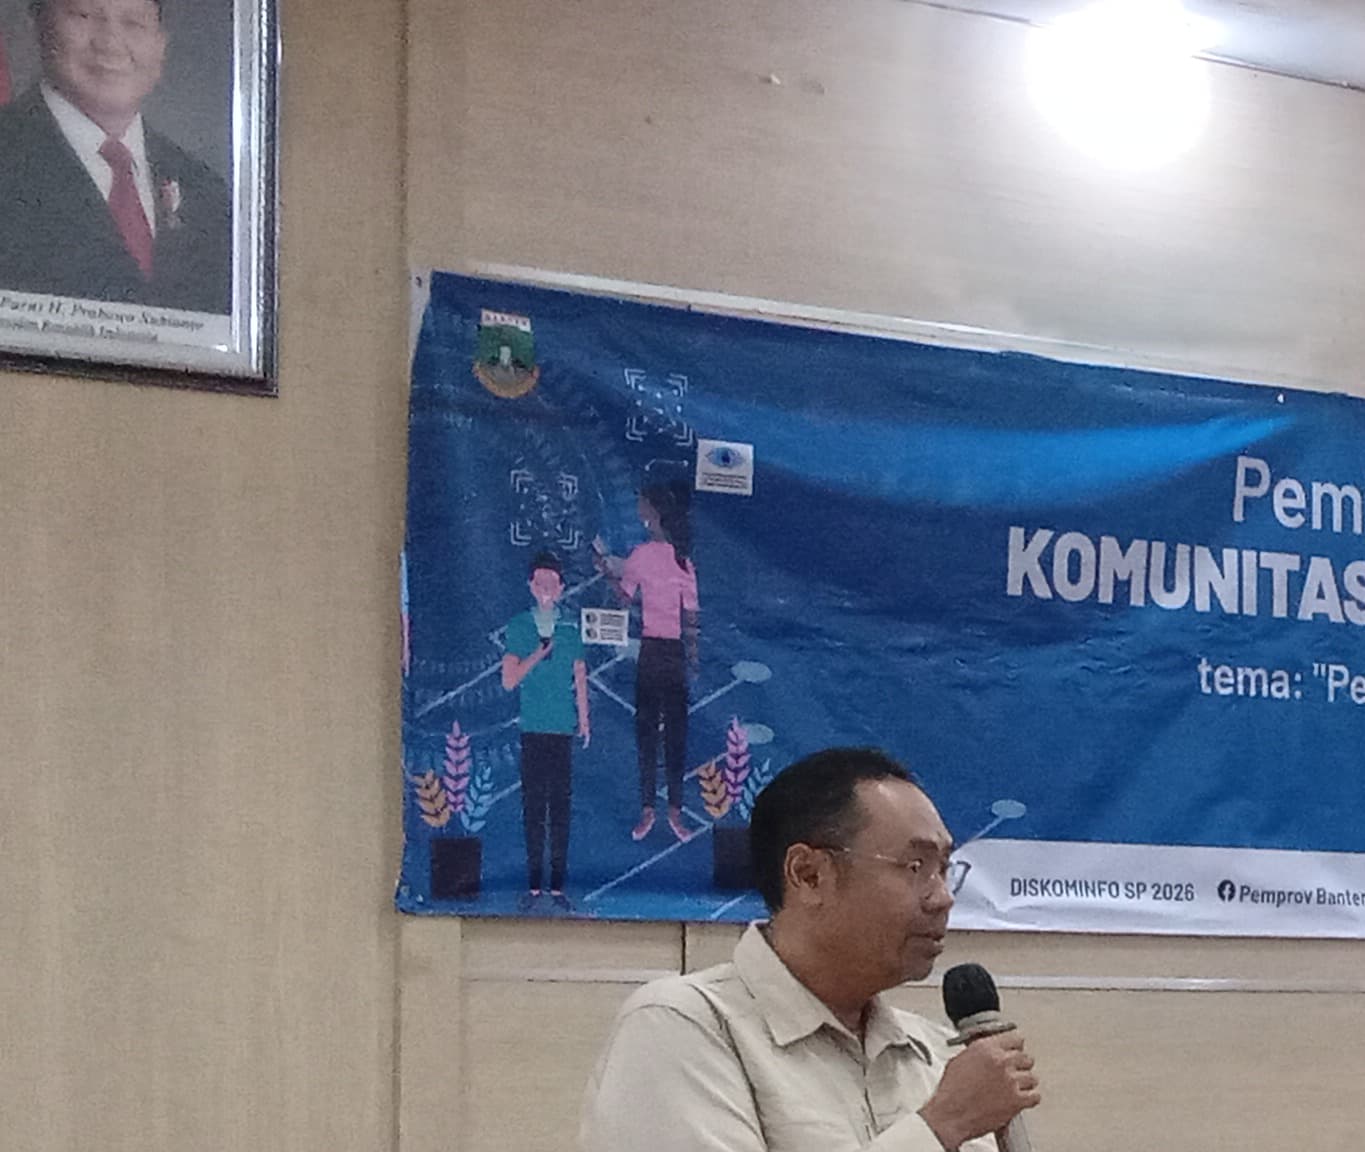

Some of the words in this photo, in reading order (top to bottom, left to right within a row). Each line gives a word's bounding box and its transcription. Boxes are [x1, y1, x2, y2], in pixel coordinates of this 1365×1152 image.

[1198, 657, 1304, 699] tema:
[1010, 878, 1120, 899] DISKOMINFO
[1124, 881, 1148, 900] SP
[1151, 882, 1195, 902] 2026
[1239, 885, 1313, 908] Pemprov
